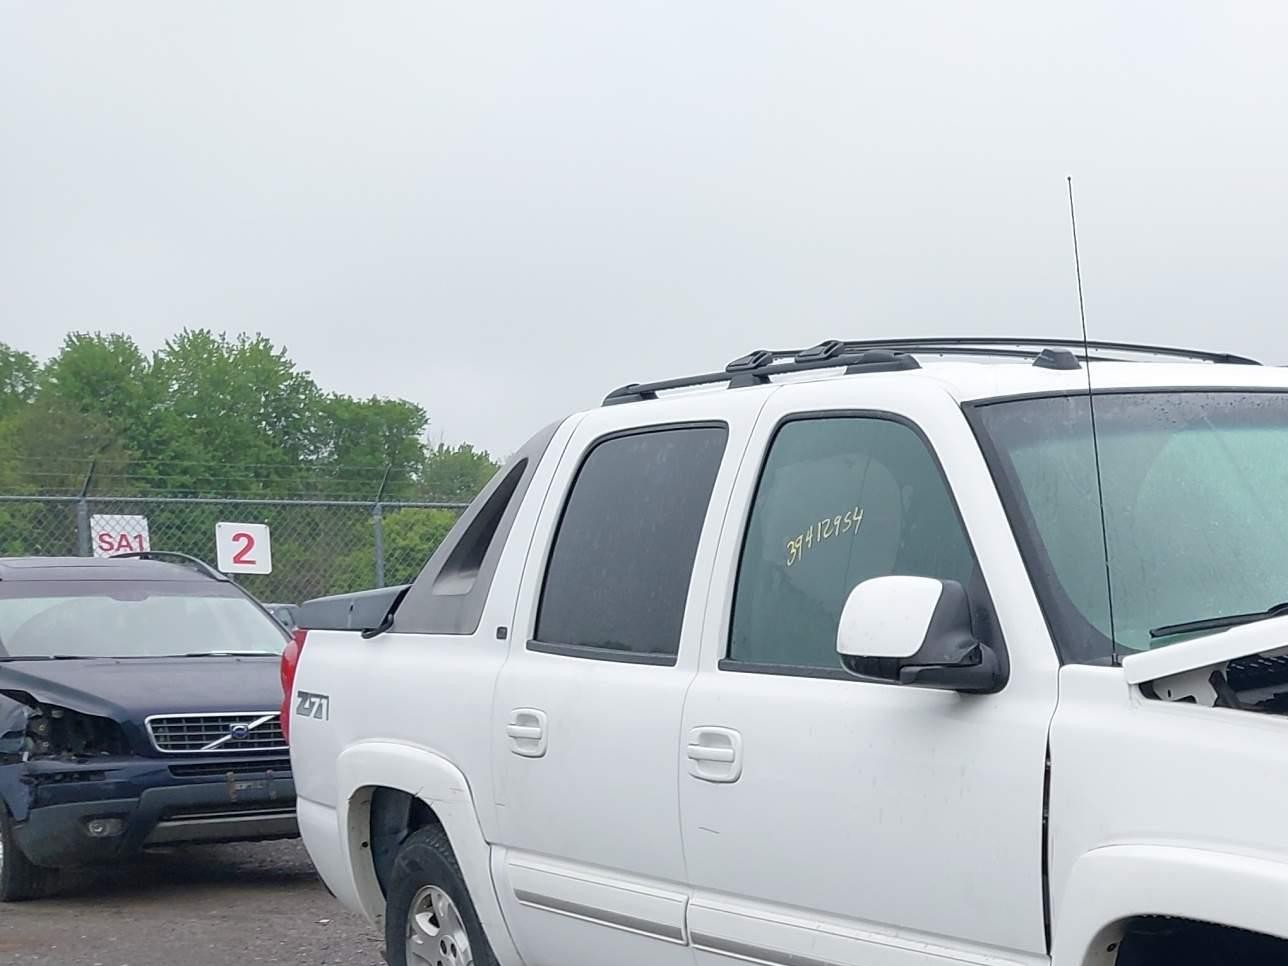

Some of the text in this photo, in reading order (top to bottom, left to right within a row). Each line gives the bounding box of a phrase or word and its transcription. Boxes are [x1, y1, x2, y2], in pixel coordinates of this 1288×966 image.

[98, 532, 145, 553] SA1
[231, 532, 257, 565] 2
[786, 506, 864, 567] 39412954
[296, 690, 330, 721] Z71
